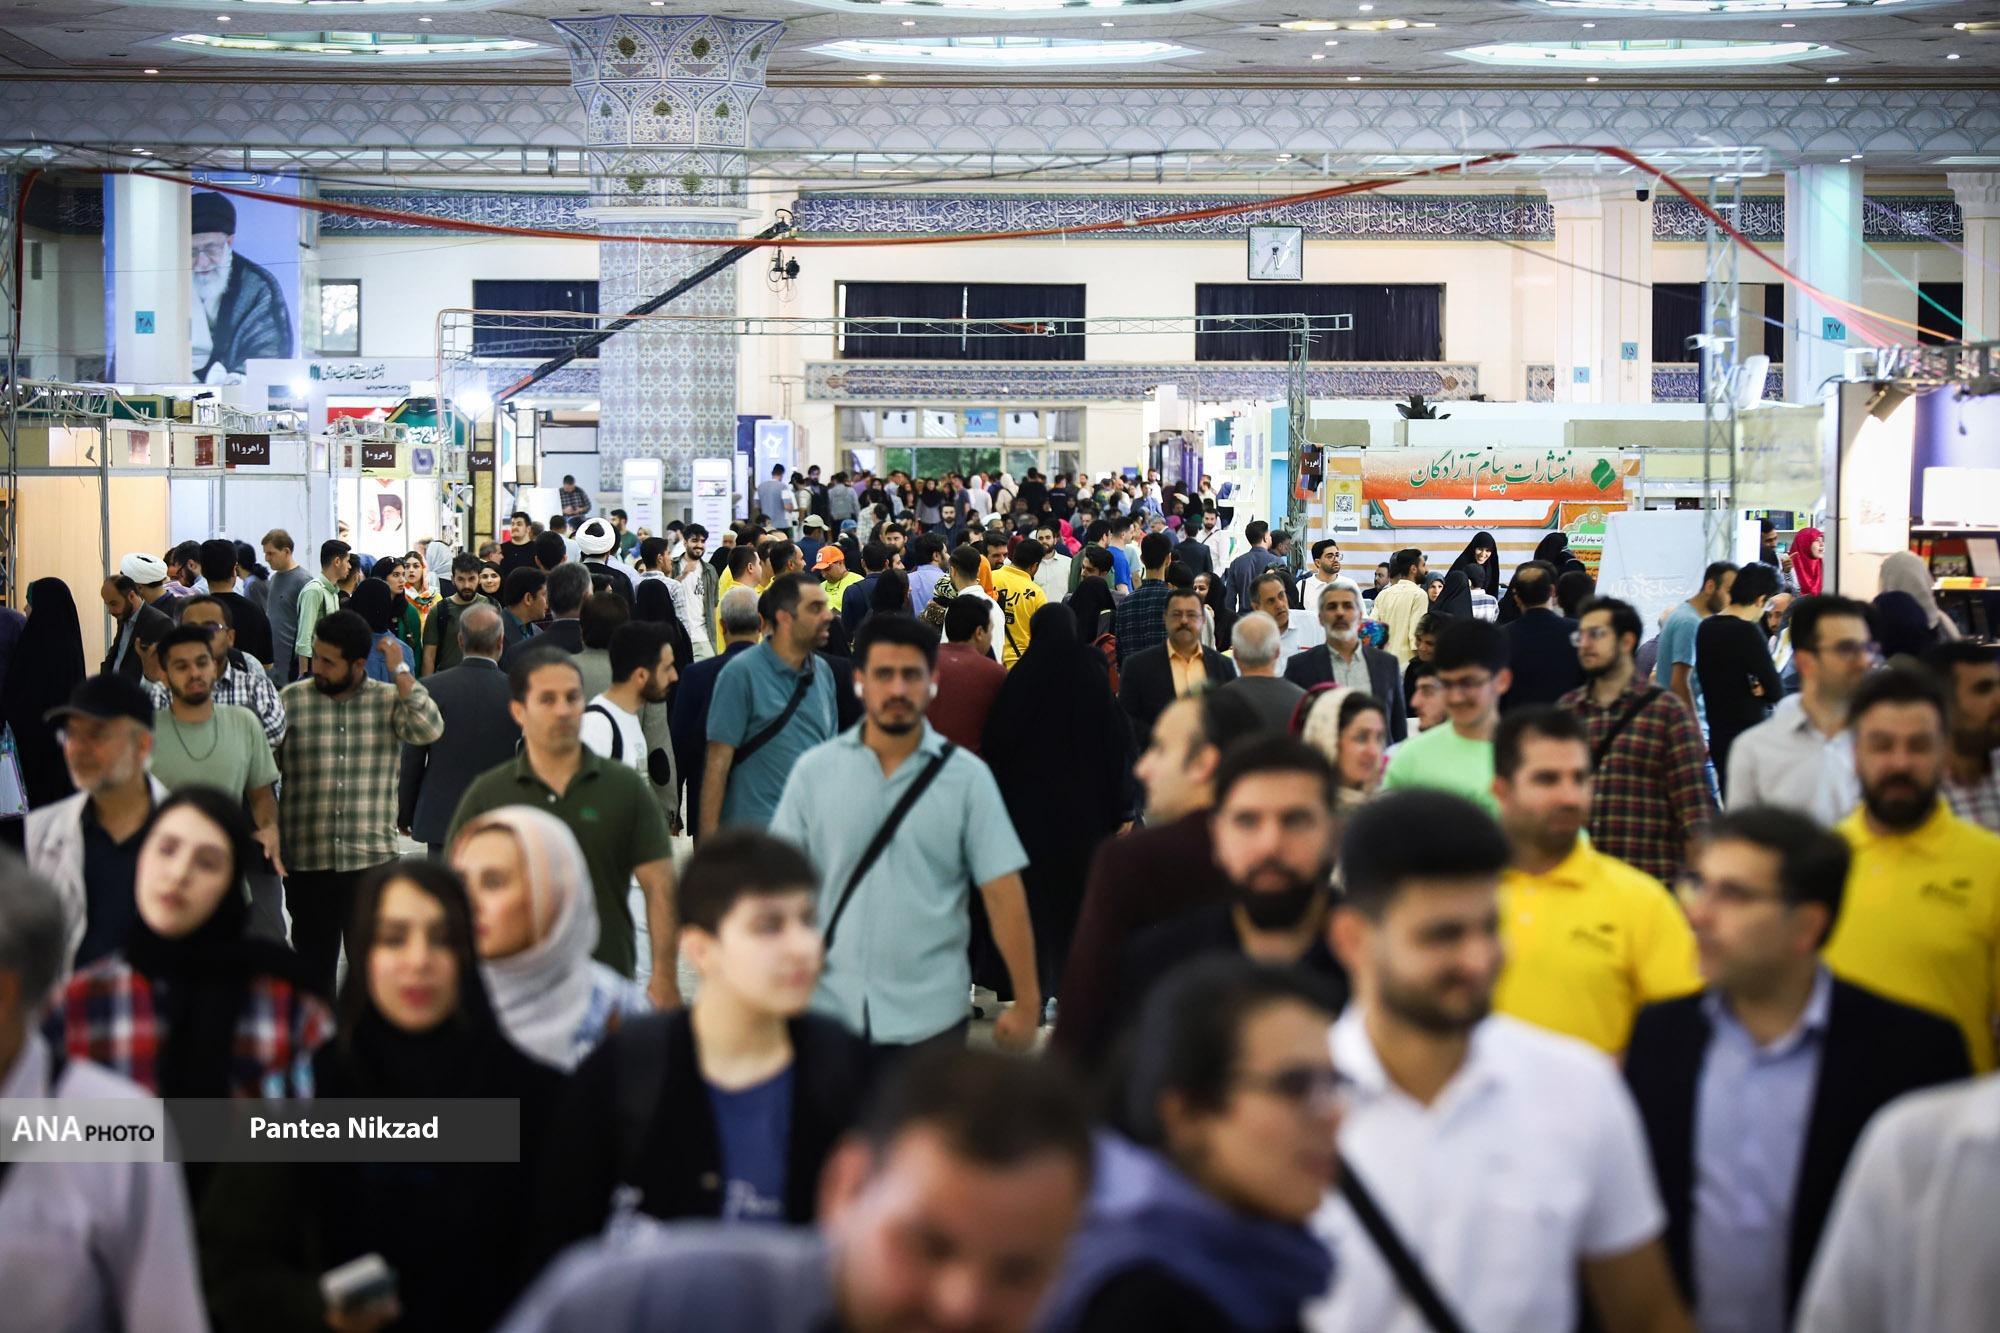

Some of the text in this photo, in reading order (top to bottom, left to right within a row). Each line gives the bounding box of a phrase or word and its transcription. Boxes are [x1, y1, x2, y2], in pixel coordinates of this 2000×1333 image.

[1827, 323, 1841, 335] ۲۷
[1409, 448, 1575, 498] انتشارات پیام آزادگان
